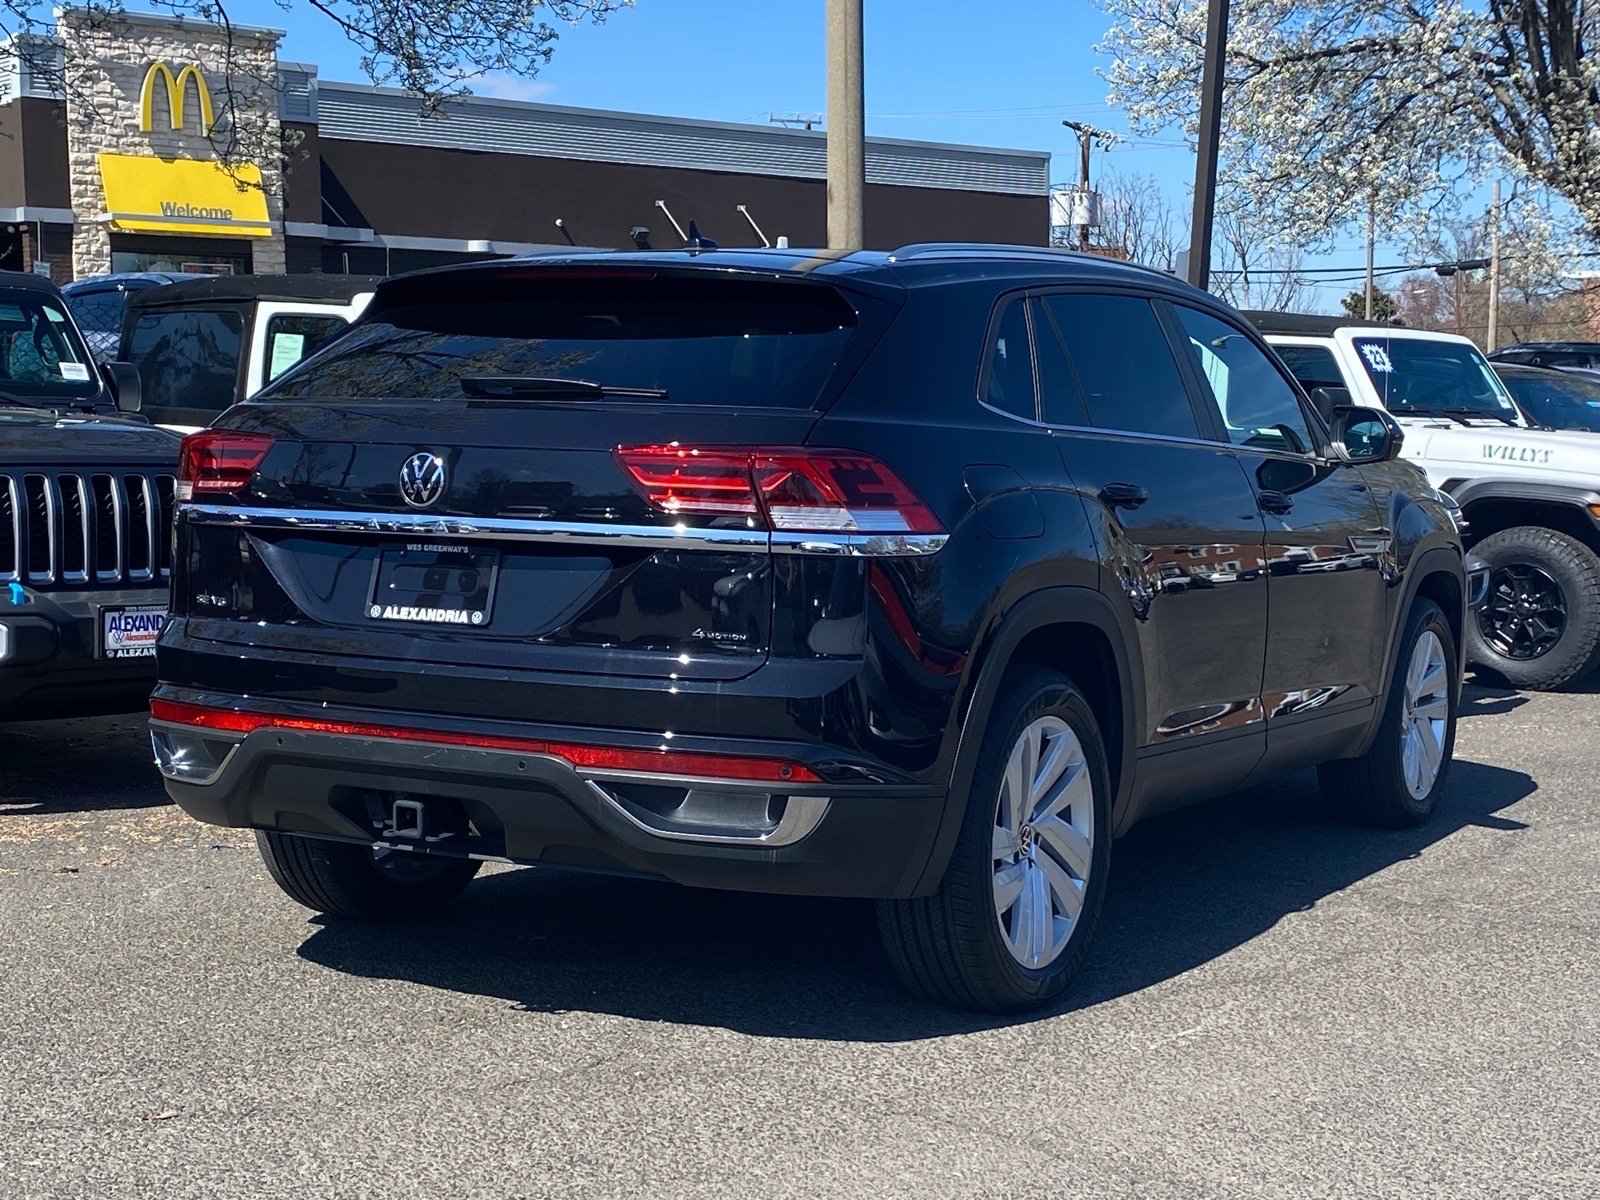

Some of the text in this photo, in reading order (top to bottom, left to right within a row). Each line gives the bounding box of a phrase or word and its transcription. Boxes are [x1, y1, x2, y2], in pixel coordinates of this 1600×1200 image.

[160, 201, 233, 219] Welcome
[1482, 444, 1554, 463] WILLYS
[406, 544, 469, 553] WES GREENWAY'S
[382, 605, 469, 624] ALEXANDRIA
